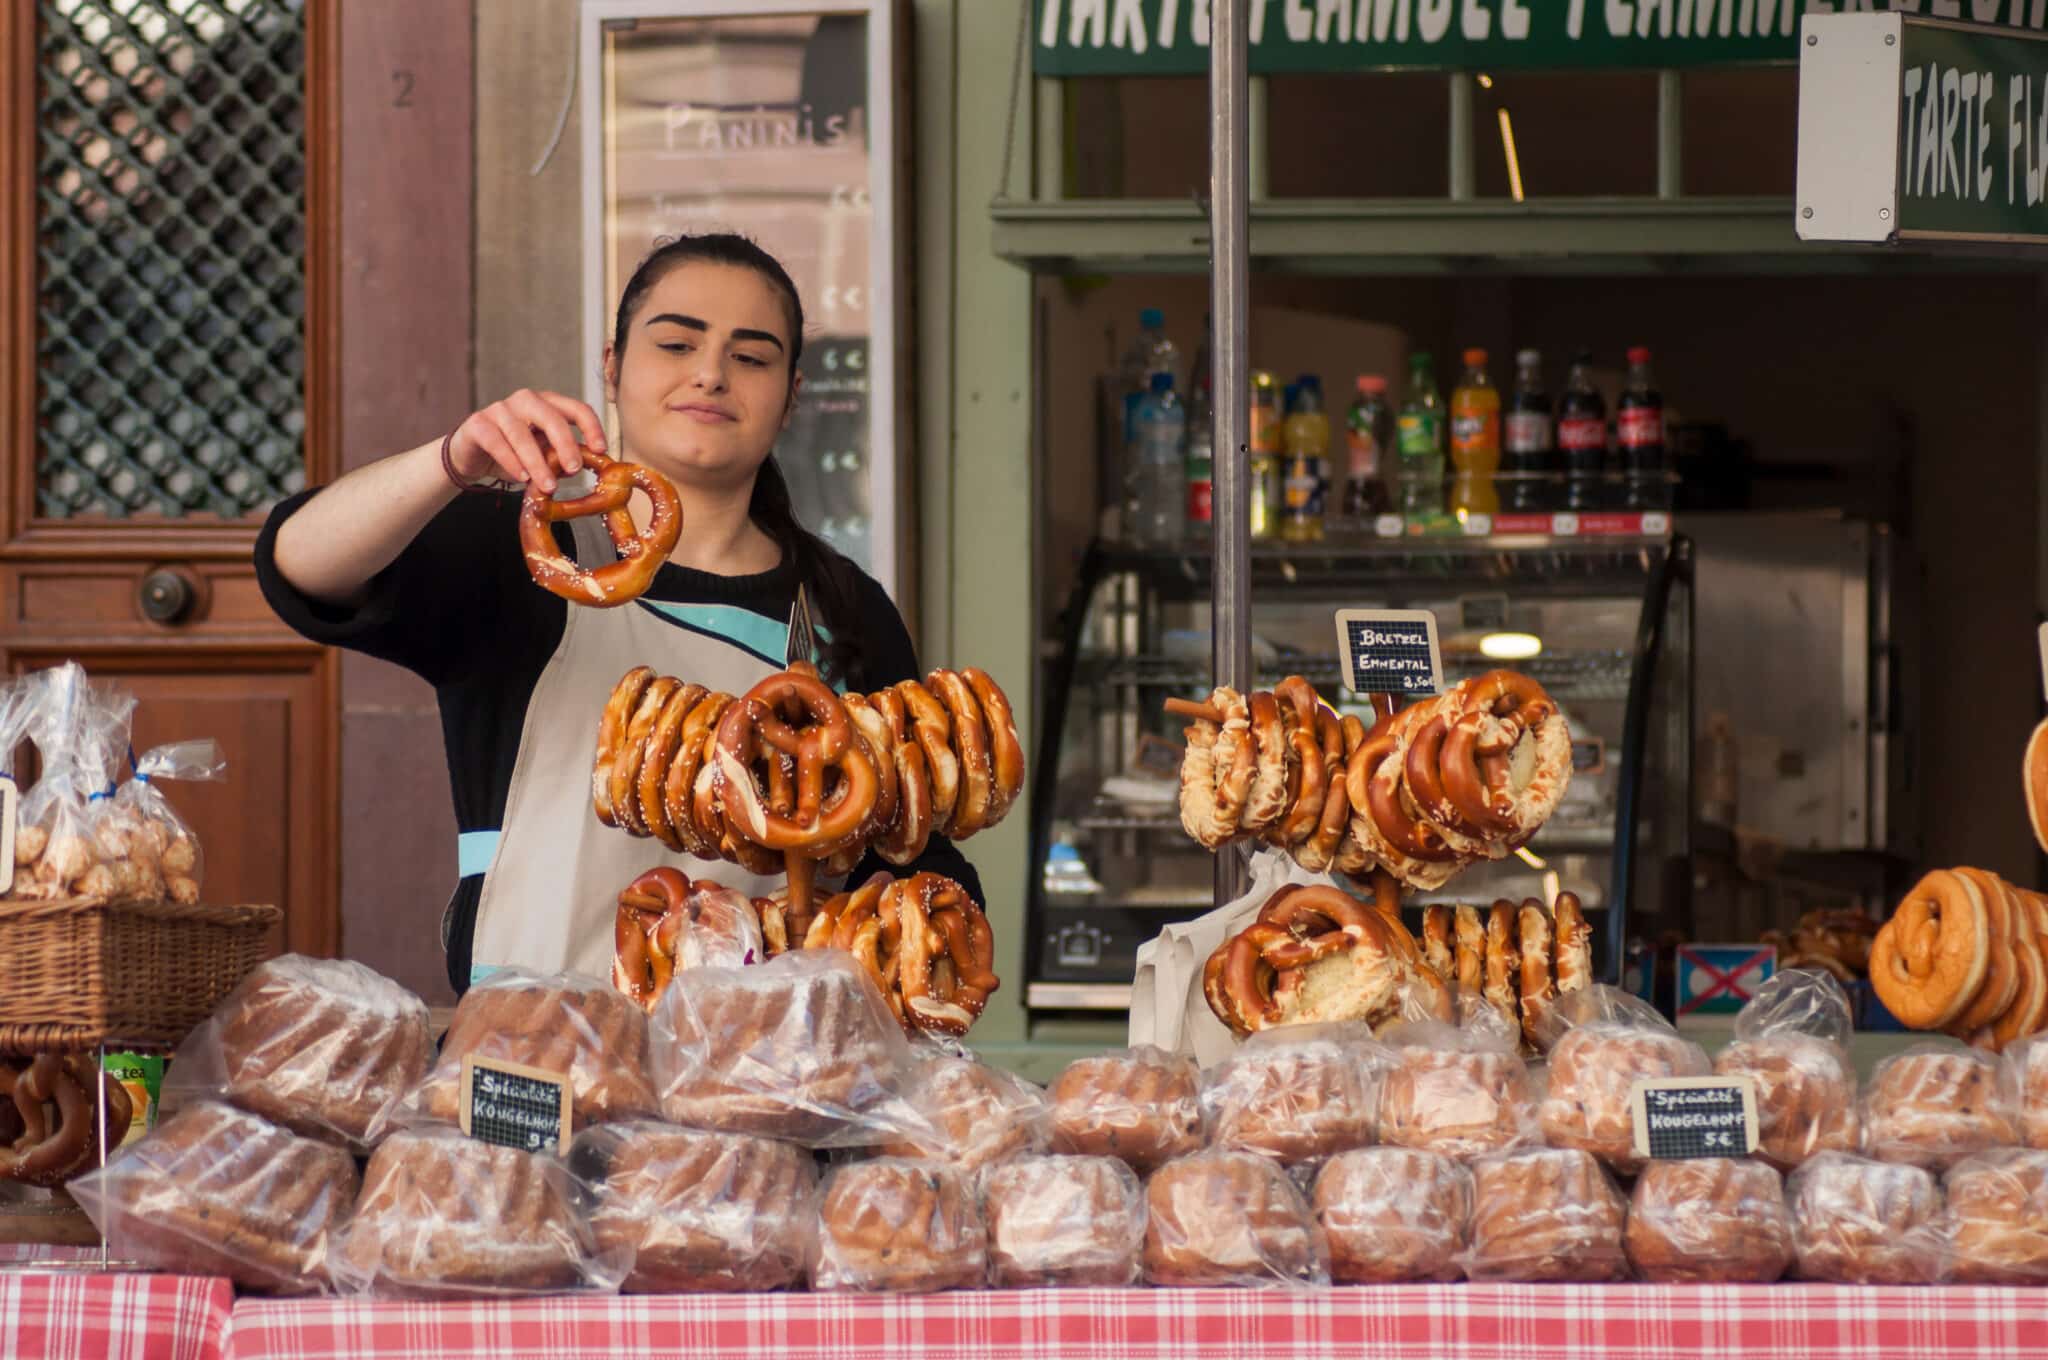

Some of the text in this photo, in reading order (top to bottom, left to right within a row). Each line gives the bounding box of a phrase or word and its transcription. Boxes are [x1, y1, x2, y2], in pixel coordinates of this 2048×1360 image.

[391, 70, 416, 107] 2
[1904, 61, 1993, 202] TARTE
[1359, 629, 1428, 646] BRETZEL
